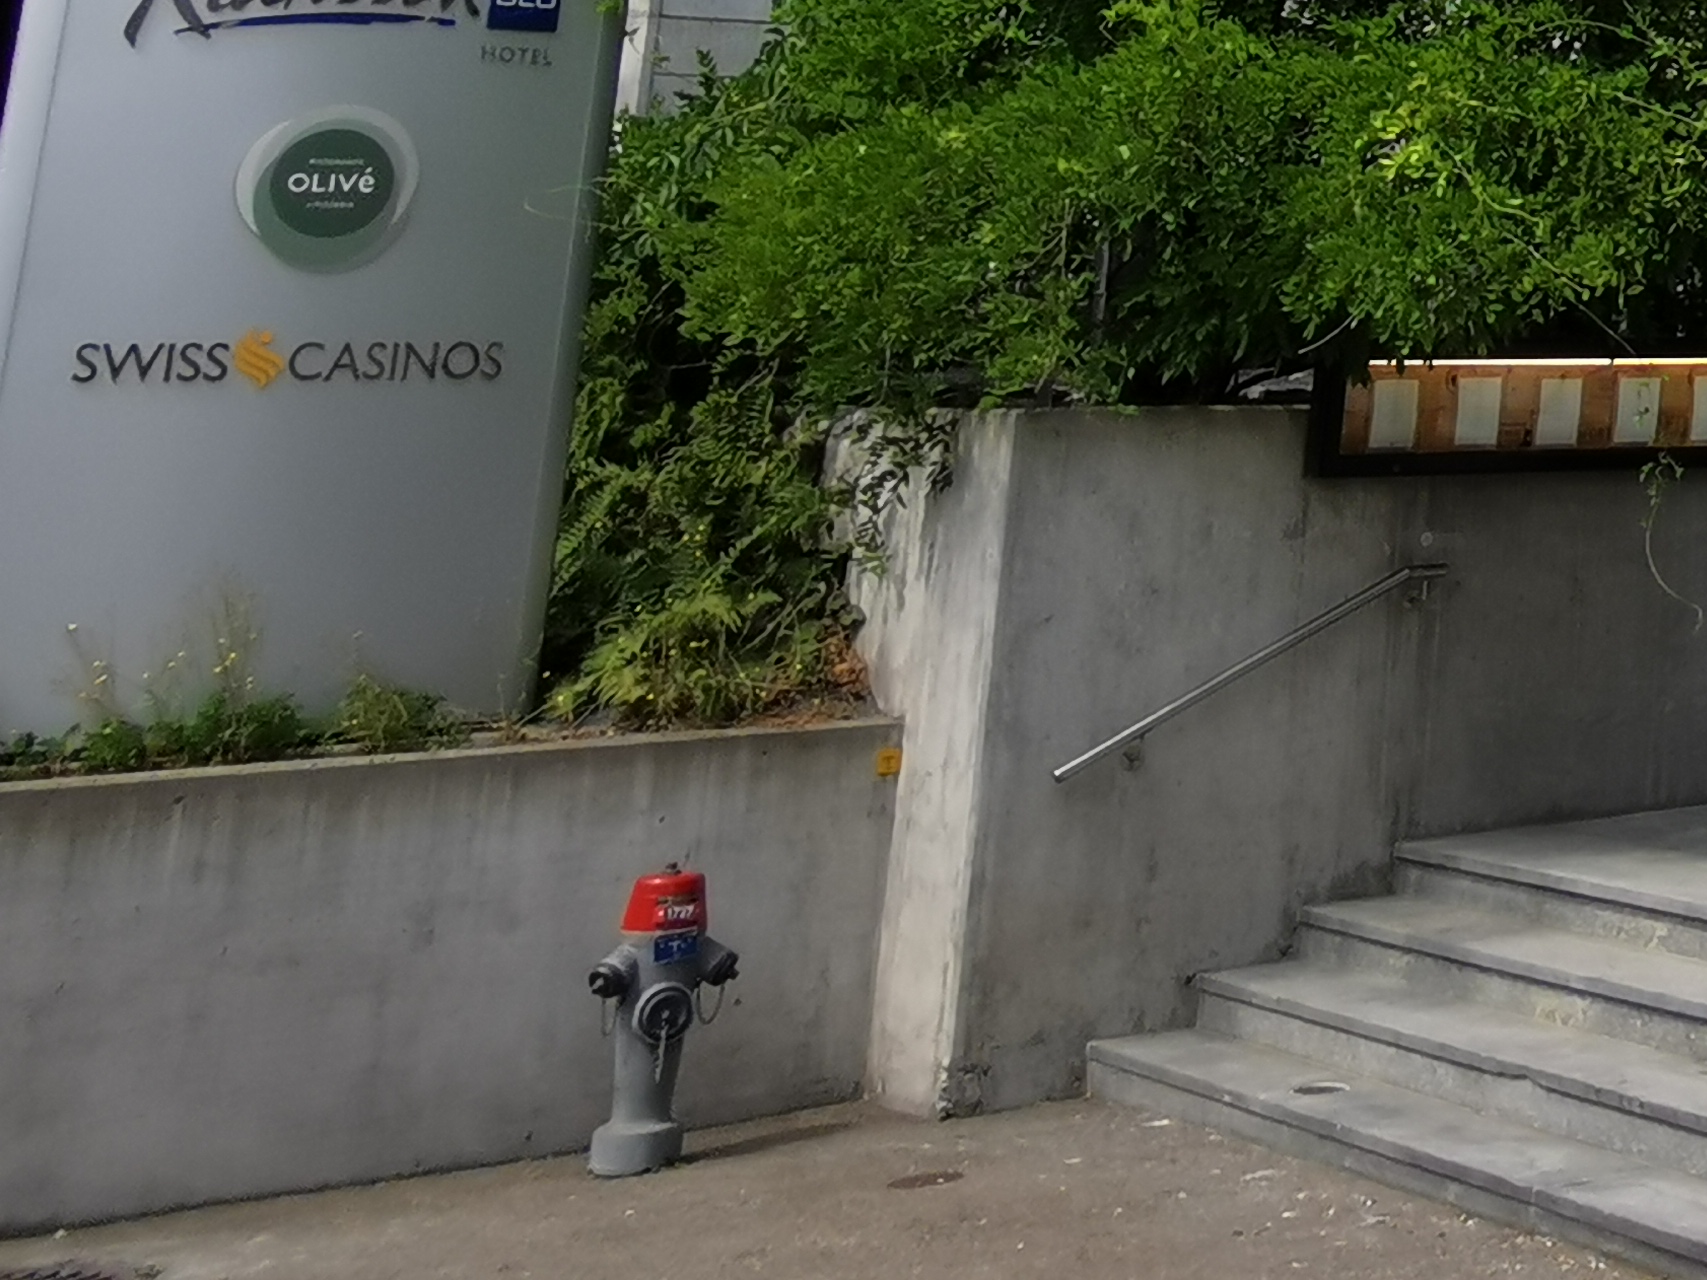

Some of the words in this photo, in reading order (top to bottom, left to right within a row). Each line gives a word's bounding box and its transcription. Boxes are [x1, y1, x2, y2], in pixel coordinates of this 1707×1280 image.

[480, 45, 553, 67] HOTEL
[70, 342, 230, 384] SWISS
[287, 340, 504, 383] CASINOS
